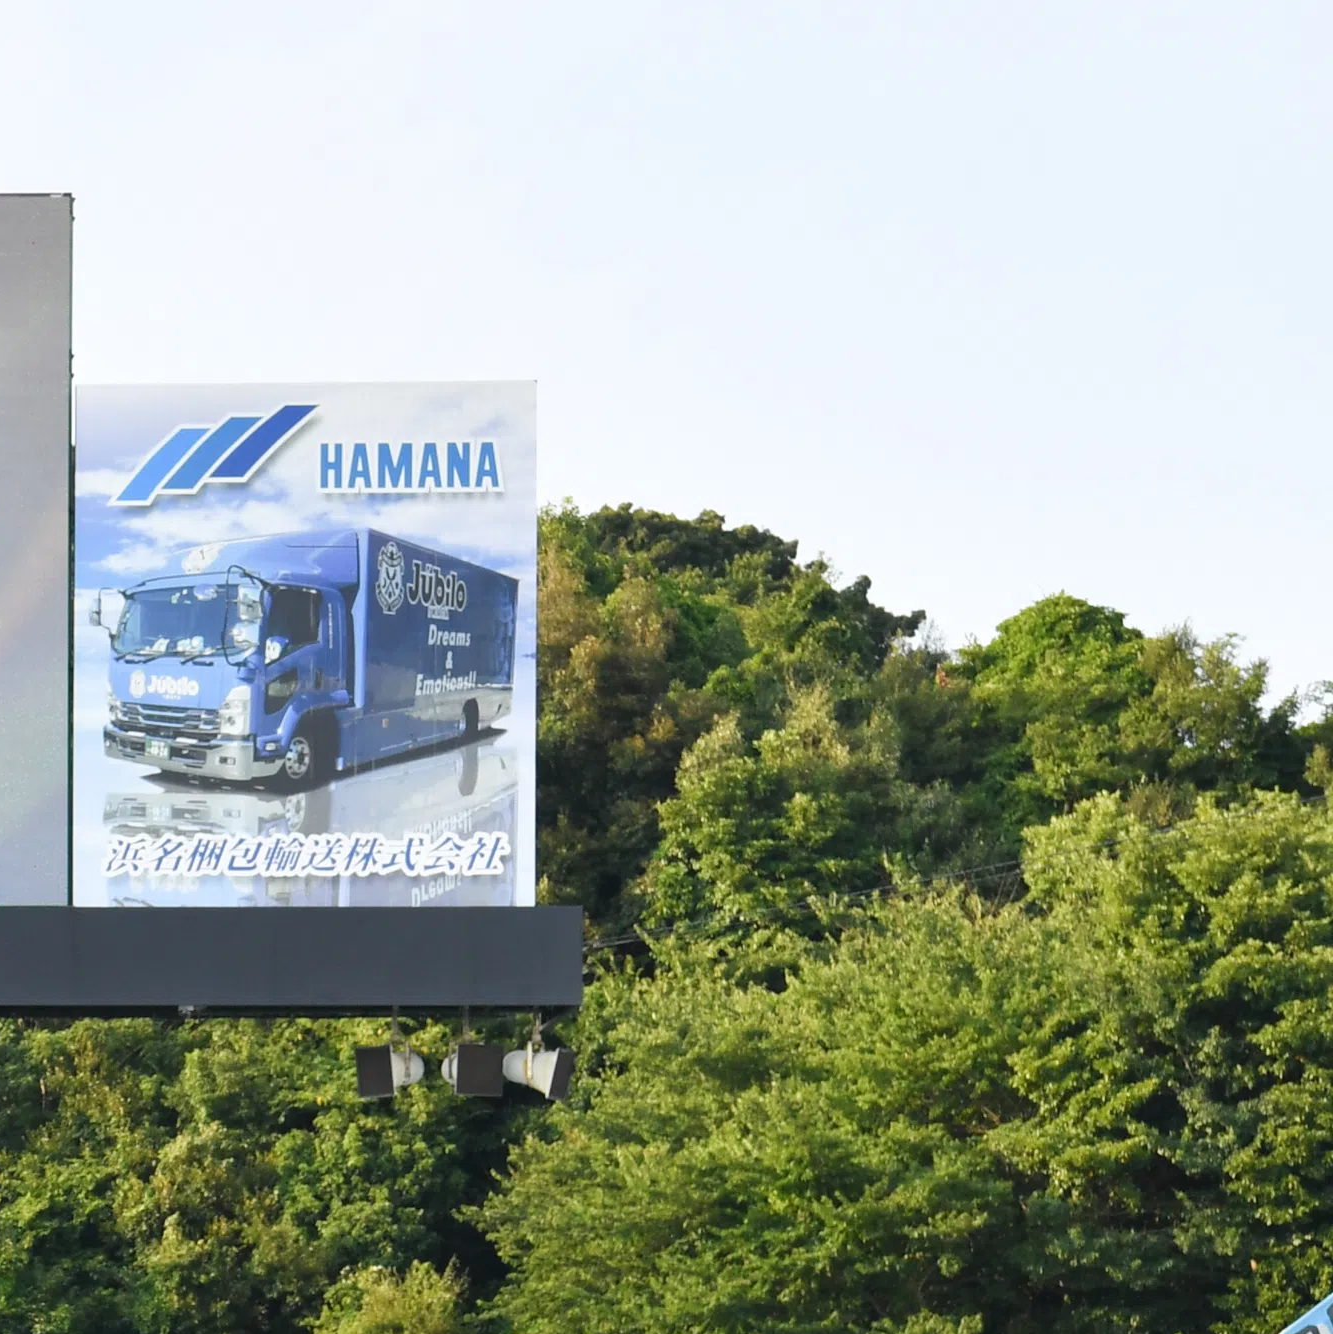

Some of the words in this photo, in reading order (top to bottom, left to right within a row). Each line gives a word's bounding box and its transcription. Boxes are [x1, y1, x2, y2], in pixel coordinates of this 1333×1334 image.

[320, 441, 500, 489] HAMANA
[428, 624, 471, 647] Dreams
[106, 835, 507, 877] 浜名梱包輸送株式会社
